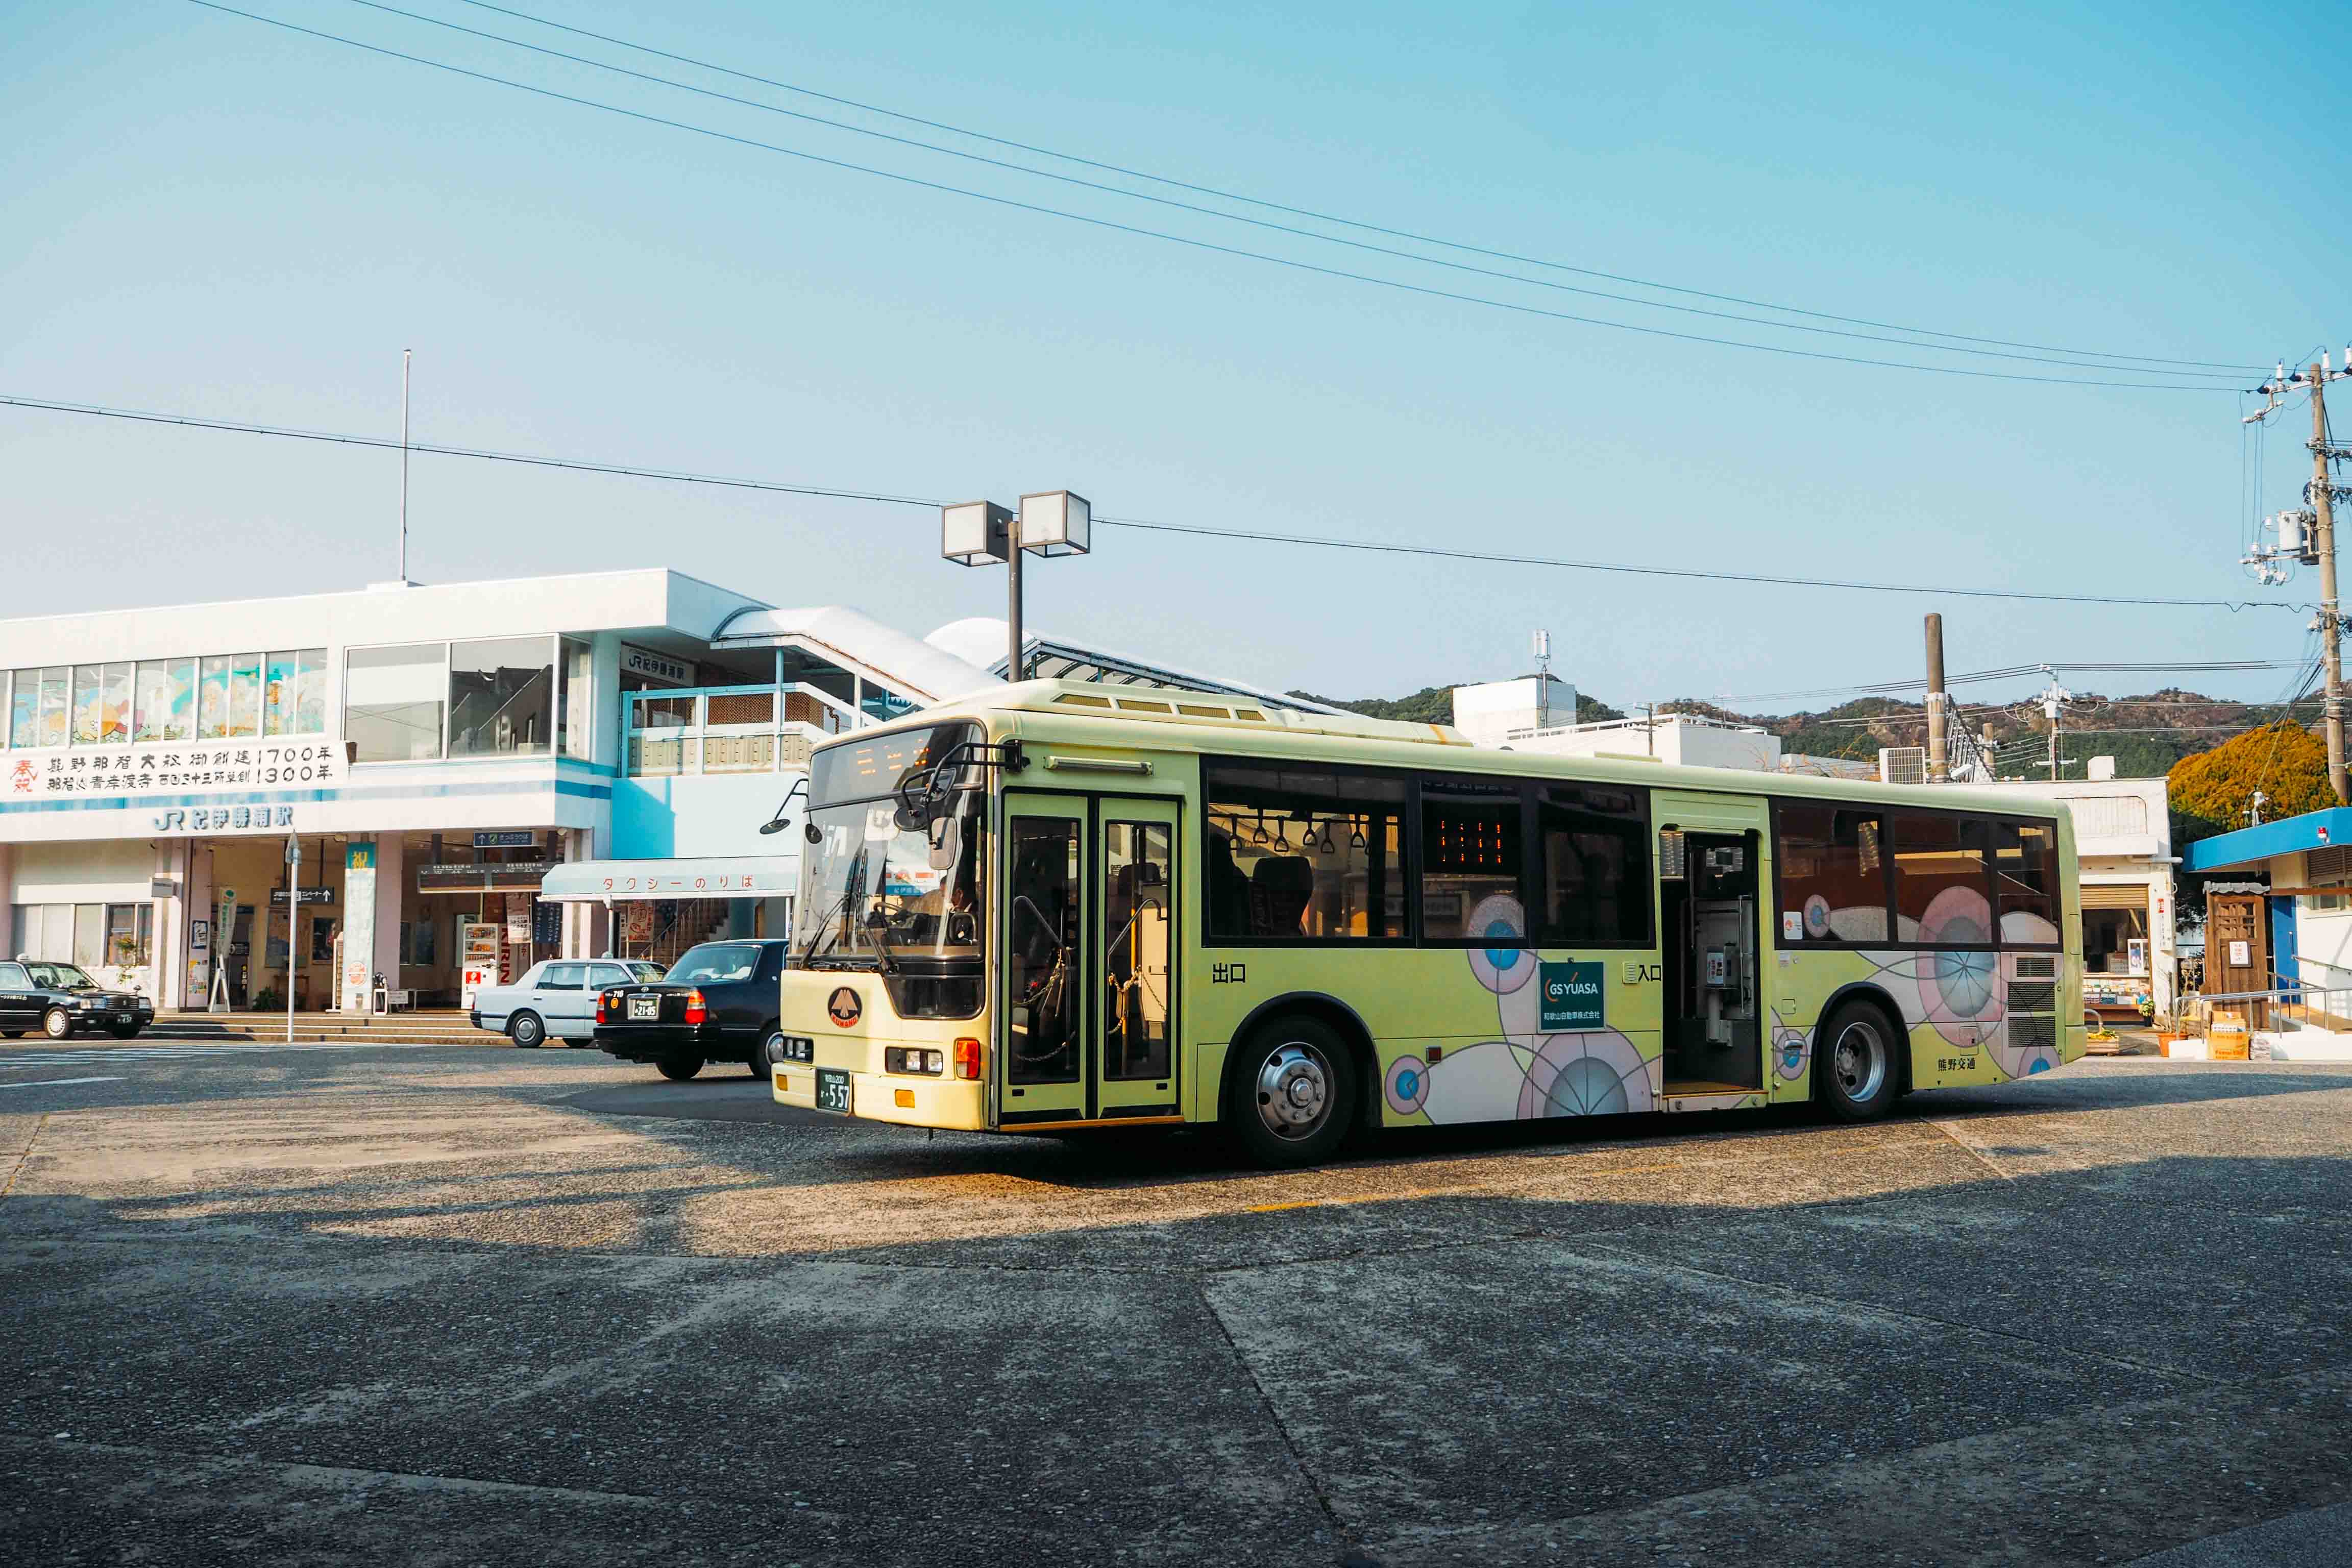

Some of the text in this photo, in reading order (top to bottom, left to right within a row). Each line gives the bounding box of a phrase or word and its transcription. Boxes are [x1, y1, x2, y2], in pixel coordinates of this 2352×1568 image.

[603, 875, 753, 890] タクシーのりば
[1212, 963, 1245, 984] 出口
[1638, 964, 1661, 982] 入口
[1550, 983, 1598, 995] GS YUASA
[831, 1013, 858, 1027] KUMANO
[1938, 1057, 1975, 1072] 熊野交通
